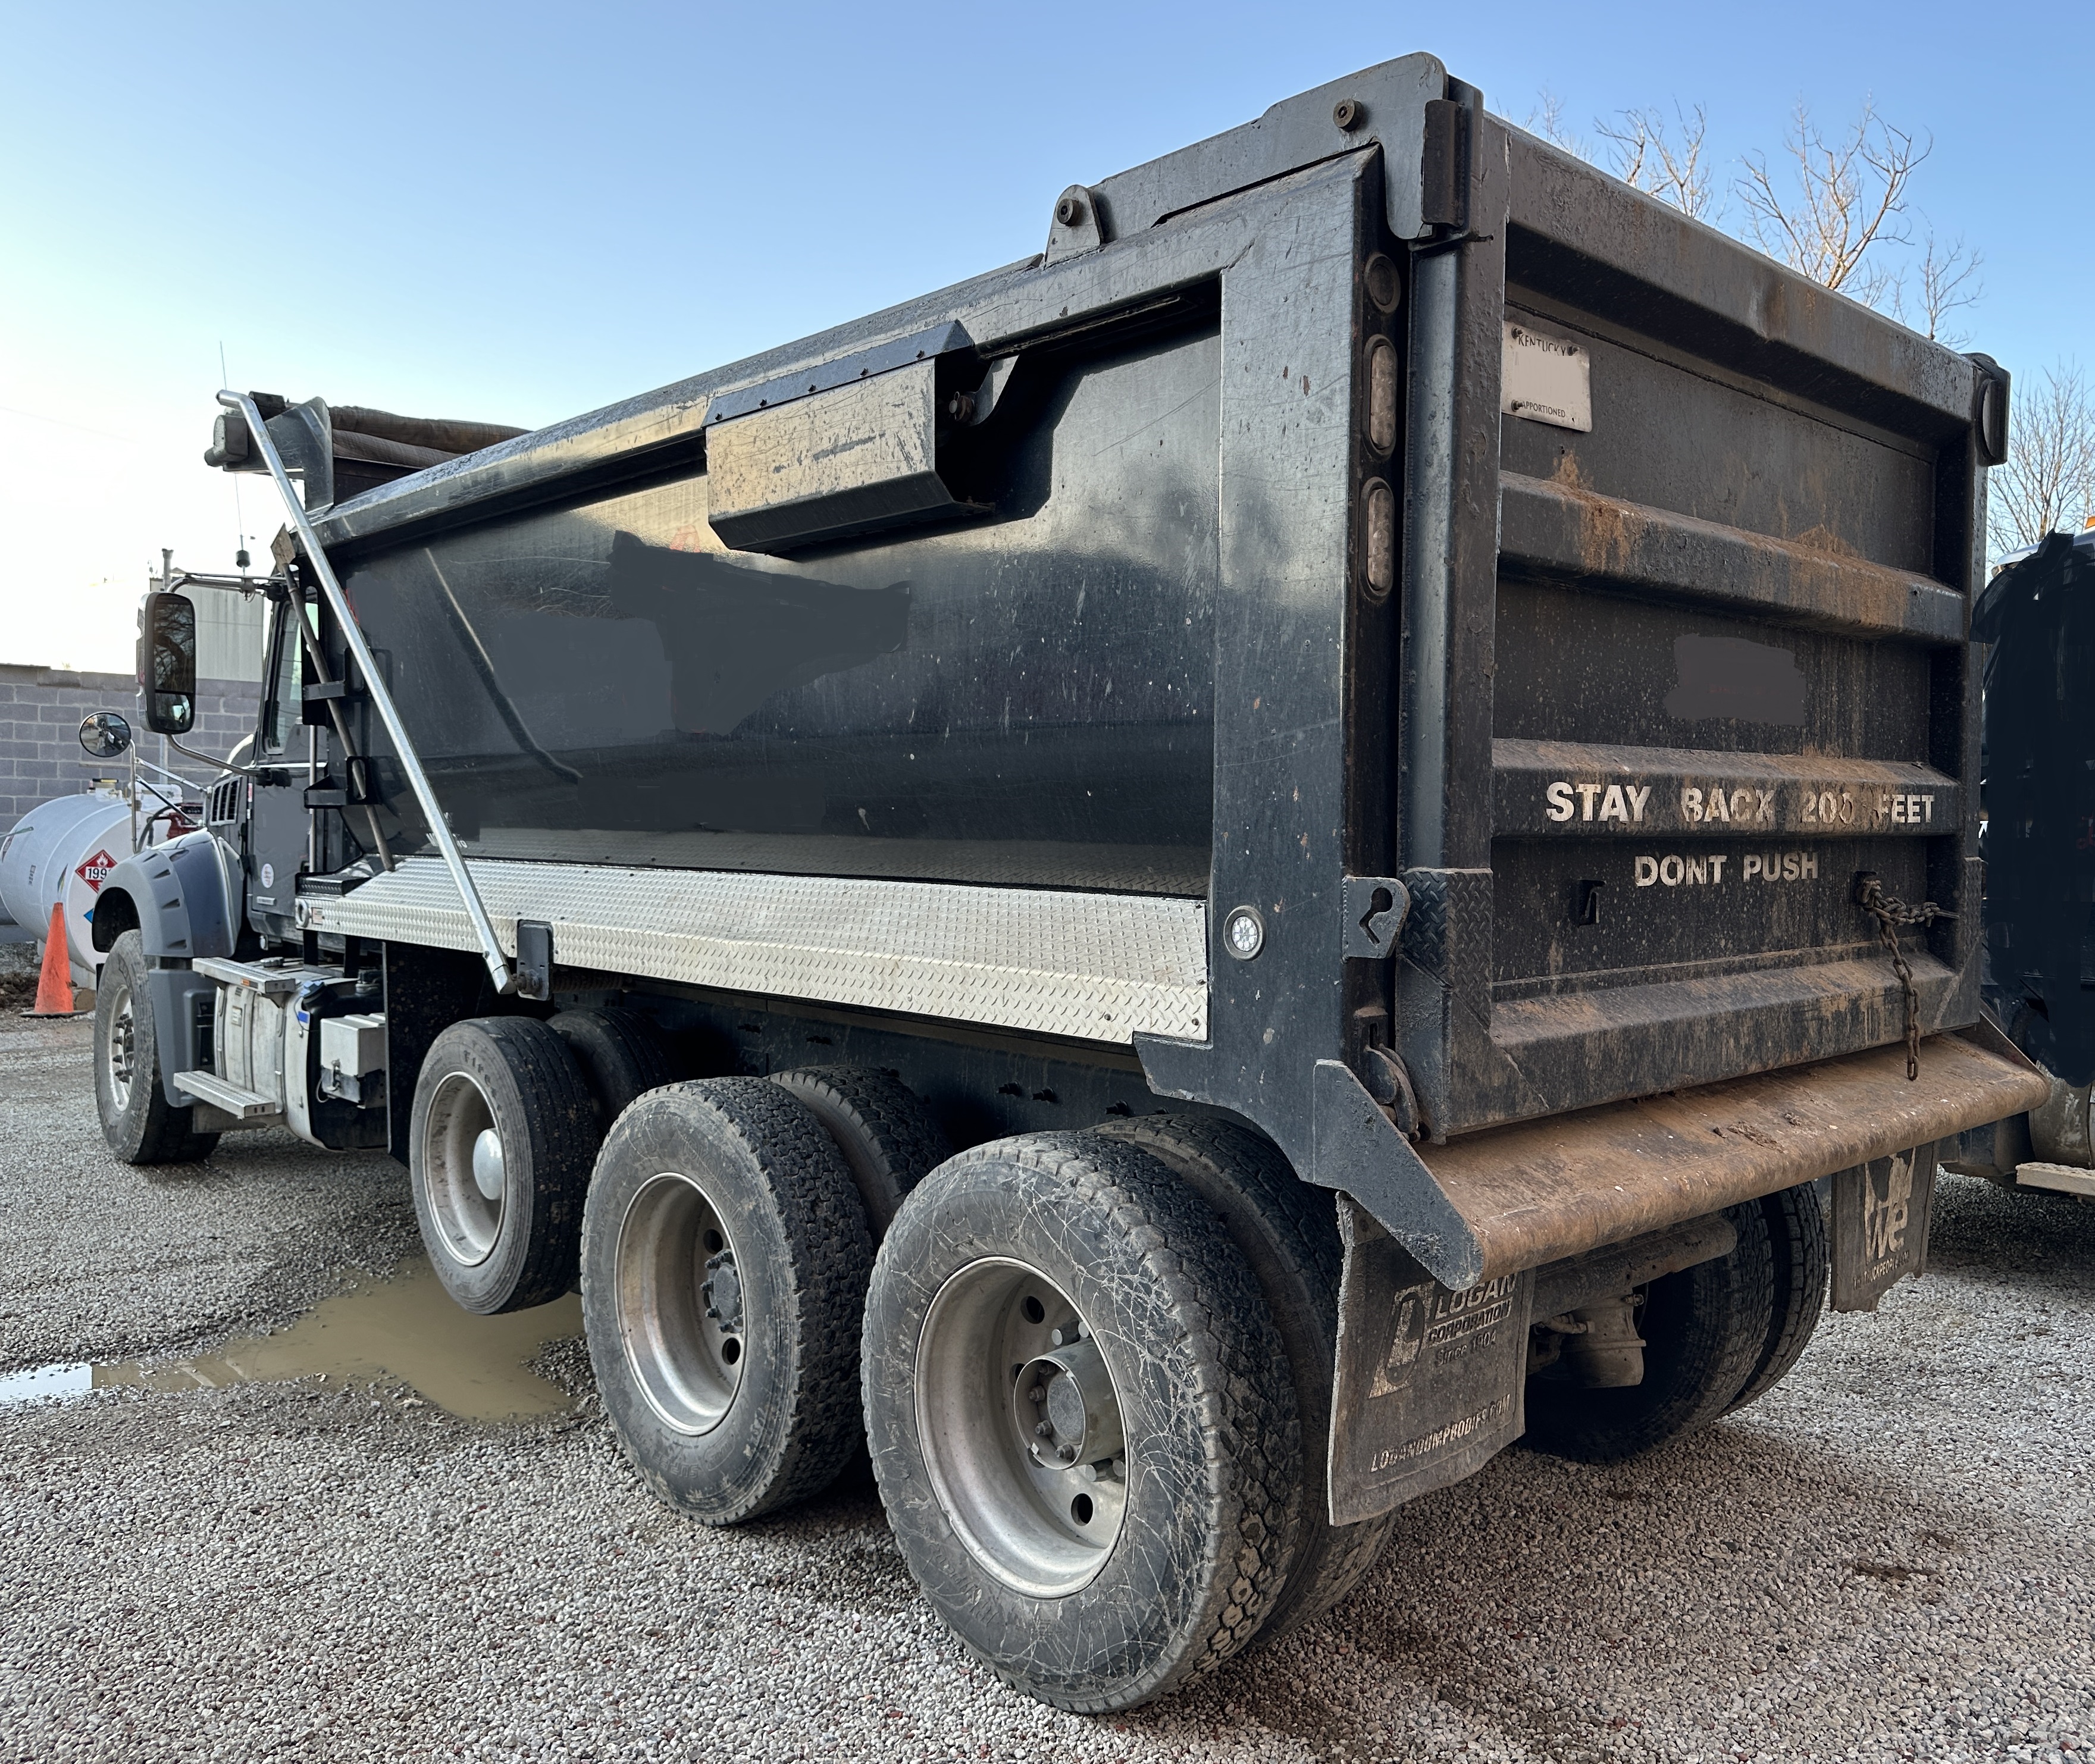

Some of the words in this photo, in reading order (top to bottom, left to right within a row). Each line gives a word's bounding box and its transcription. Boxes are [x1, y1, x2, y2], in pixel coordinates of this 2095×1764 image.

[1518, 334, 1567, 356] KENTUCKY
[1521, 401, 1565, 418] APPORTIONED
[1546, 782, 1652, 822] STAY
[1680, 787, 1776, 823] BACK
[1802, 790, 1853, 825] 200
[1878, 793, 1935, 823] FEET
[88, 867, 111, 879] 199
[1634, 854, 1727, 887] DONT
[1743, 851, 1818, 882] PUSH
[1434, 1273, 1517, 1320] LOGAN
[1429, 1299, 1512, 1343] CORPORATION
[1435, 1345, 1467, 1367] Since
